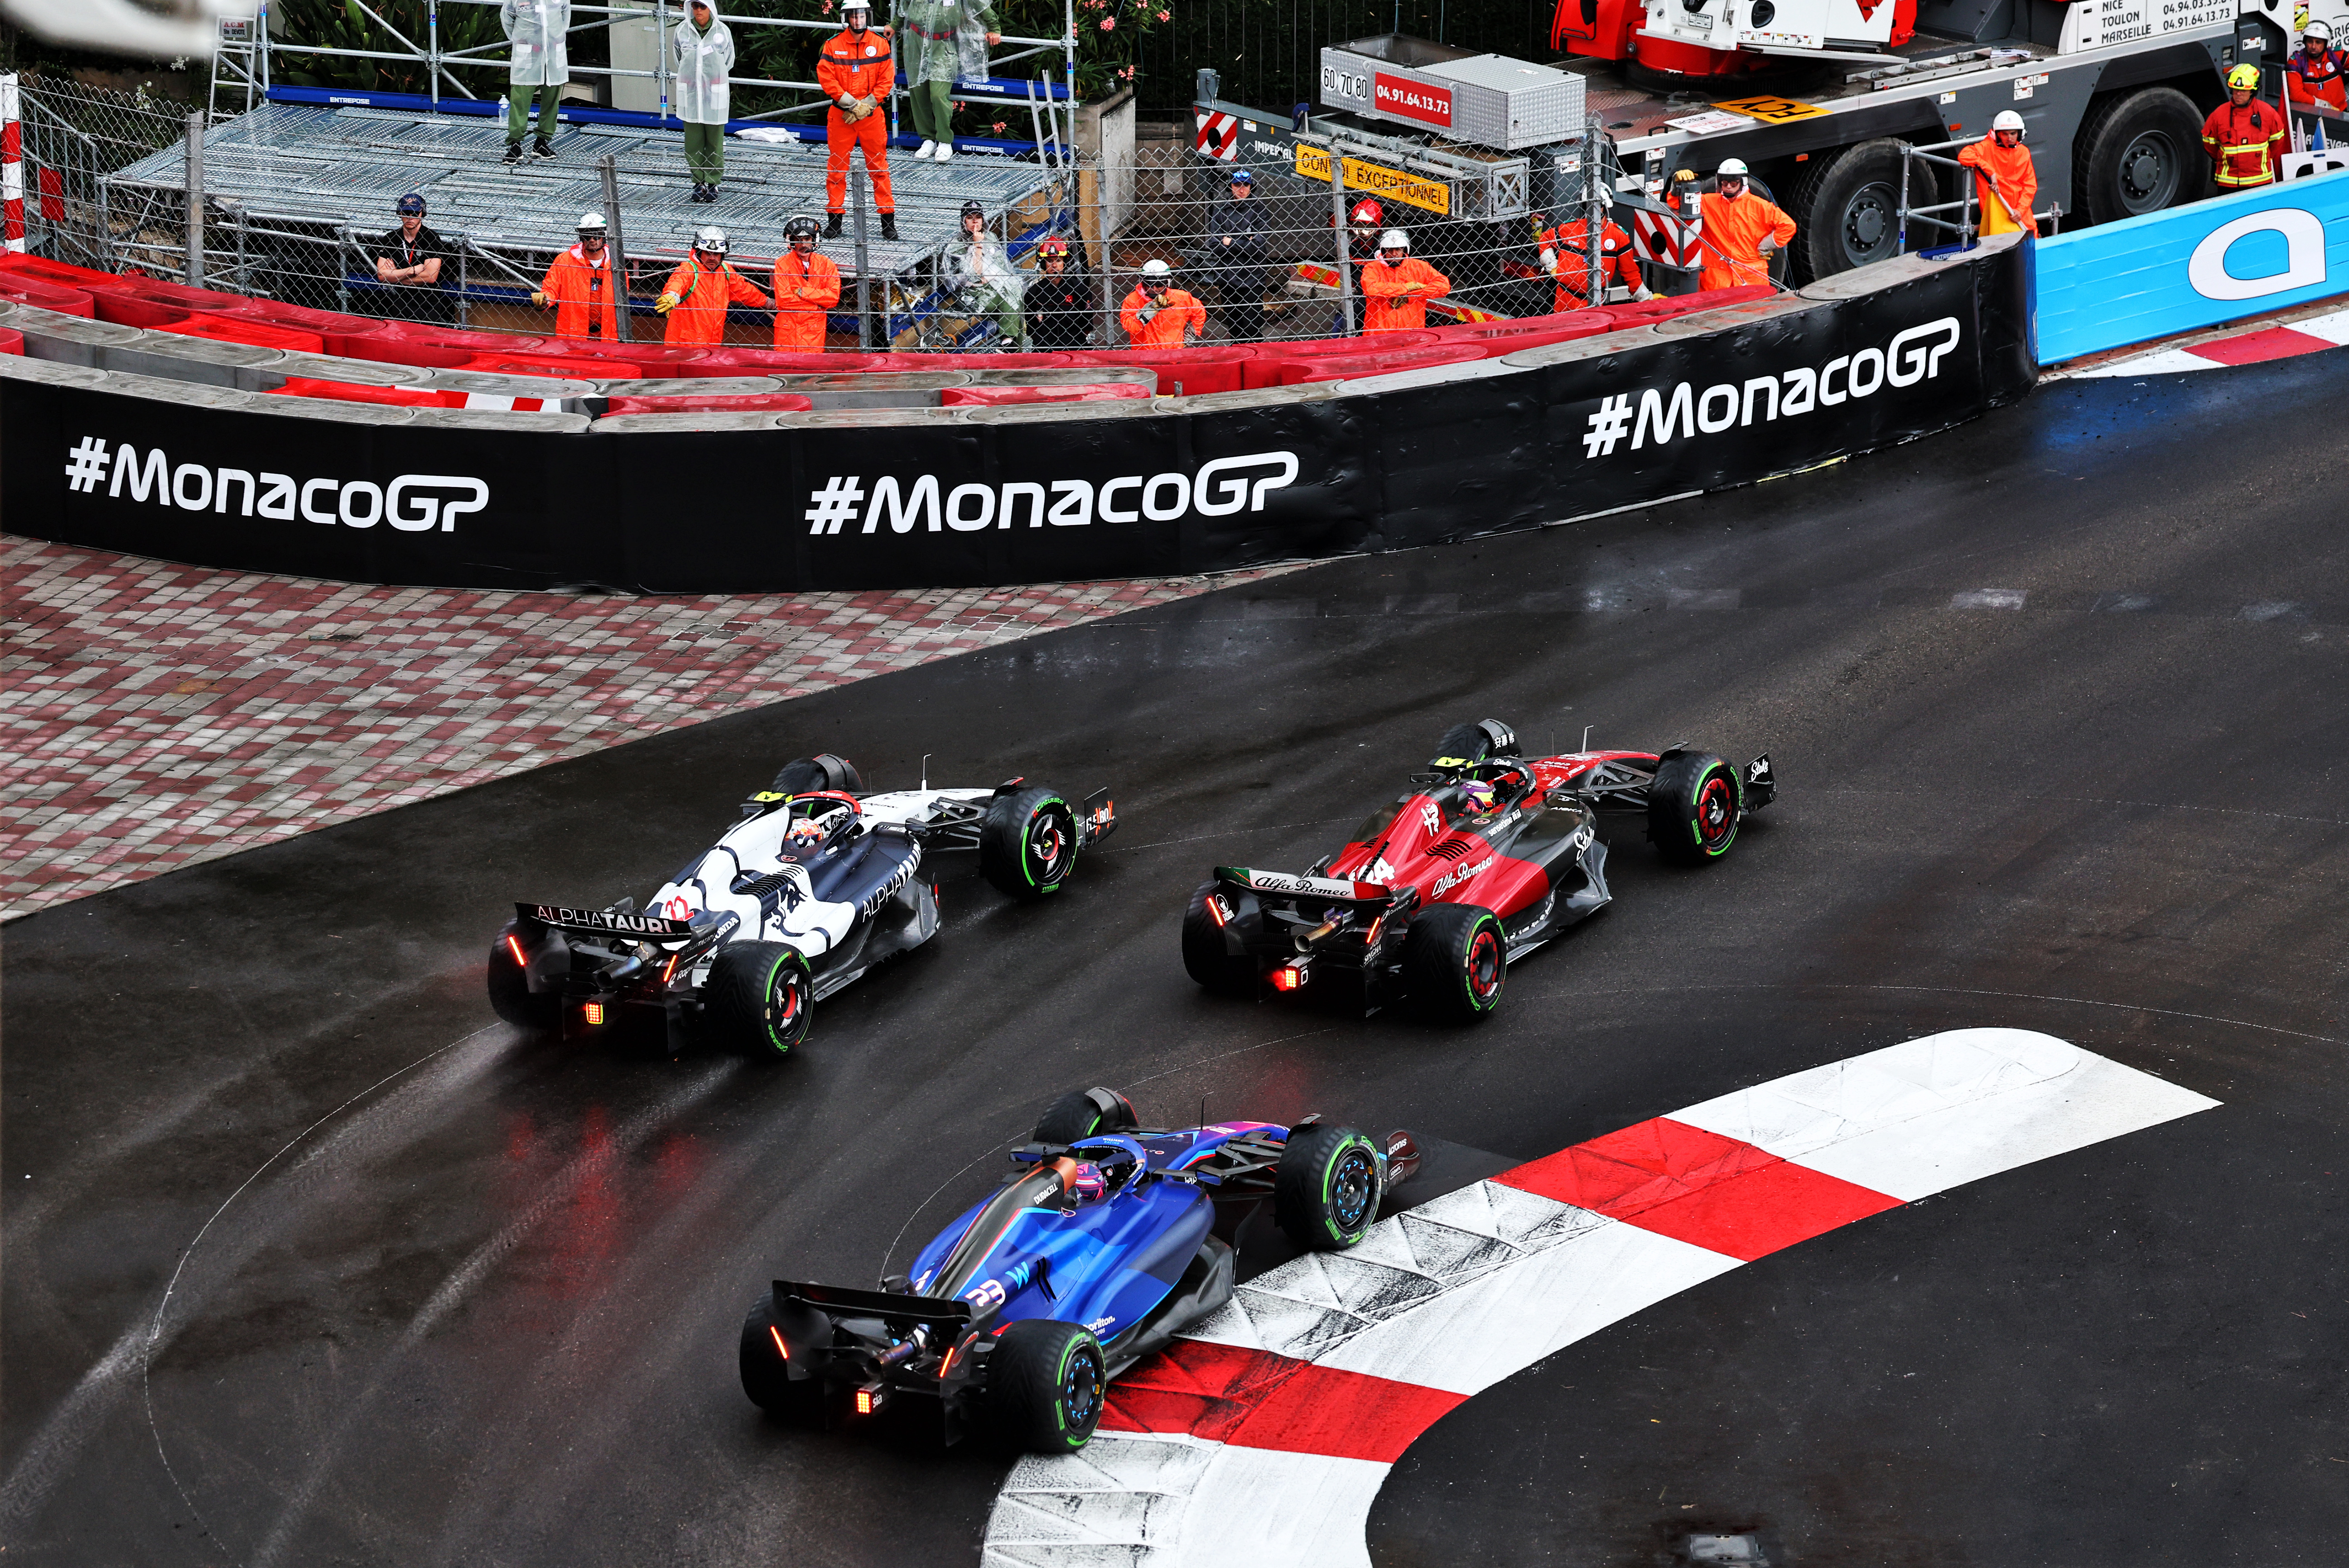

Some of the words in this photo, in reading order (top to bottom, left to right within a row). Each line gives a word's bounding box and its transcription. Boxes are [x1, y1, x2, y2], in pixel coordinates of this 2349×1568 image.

[2103, 0, 2123, 12] NICE
[2102, 11, 2140, 28] TOULON
[2163, 8, 2230, 31] 04.91.64.13.73
[2102, 24, 2151, 44] MARSEILLE
[962, 83, 1004, 92] ENTREPOSE
[1324, 69, 1335, 89] 60
[1341, 74, 1352, 95] 70
[1356, 77, 1367, 98] 80
[1377, 85, 1449, 115] 04.91.64.13.73
[962, 145, 1004, 153] ENTREPOSE
[1255, 140, 1293, 160] IMPERIAL
[1357, 167, 1445, 206] EXCEPTIONNEL
[1582, 317, 1959, 458] #MonacoGP
[65, 436, 489, 532] #MonacoGP
[804, 451, 1299, 535] #MonacoGP
[1751, 758, 1769, 782] Stake
[1035, 797, 1064, 812] Cinturato
[1488, 817, 1513, 836] sensetime
[1255, 877, 1293, 890] Alfa
[1294, 880, 1350, 896] Romeo
[1432, 872, 1458, 899] Alfa
[1457, 855, 1493, 883] Romeo
[666, 896, 695, 921] 22
[538, 906, 672, 933] ALPHATAURI
[1033, 1182, 1058, 1205] DURACELL
[965, 1279, 1006, 1307] 23
[873, 1394, 882, 1409] sia
